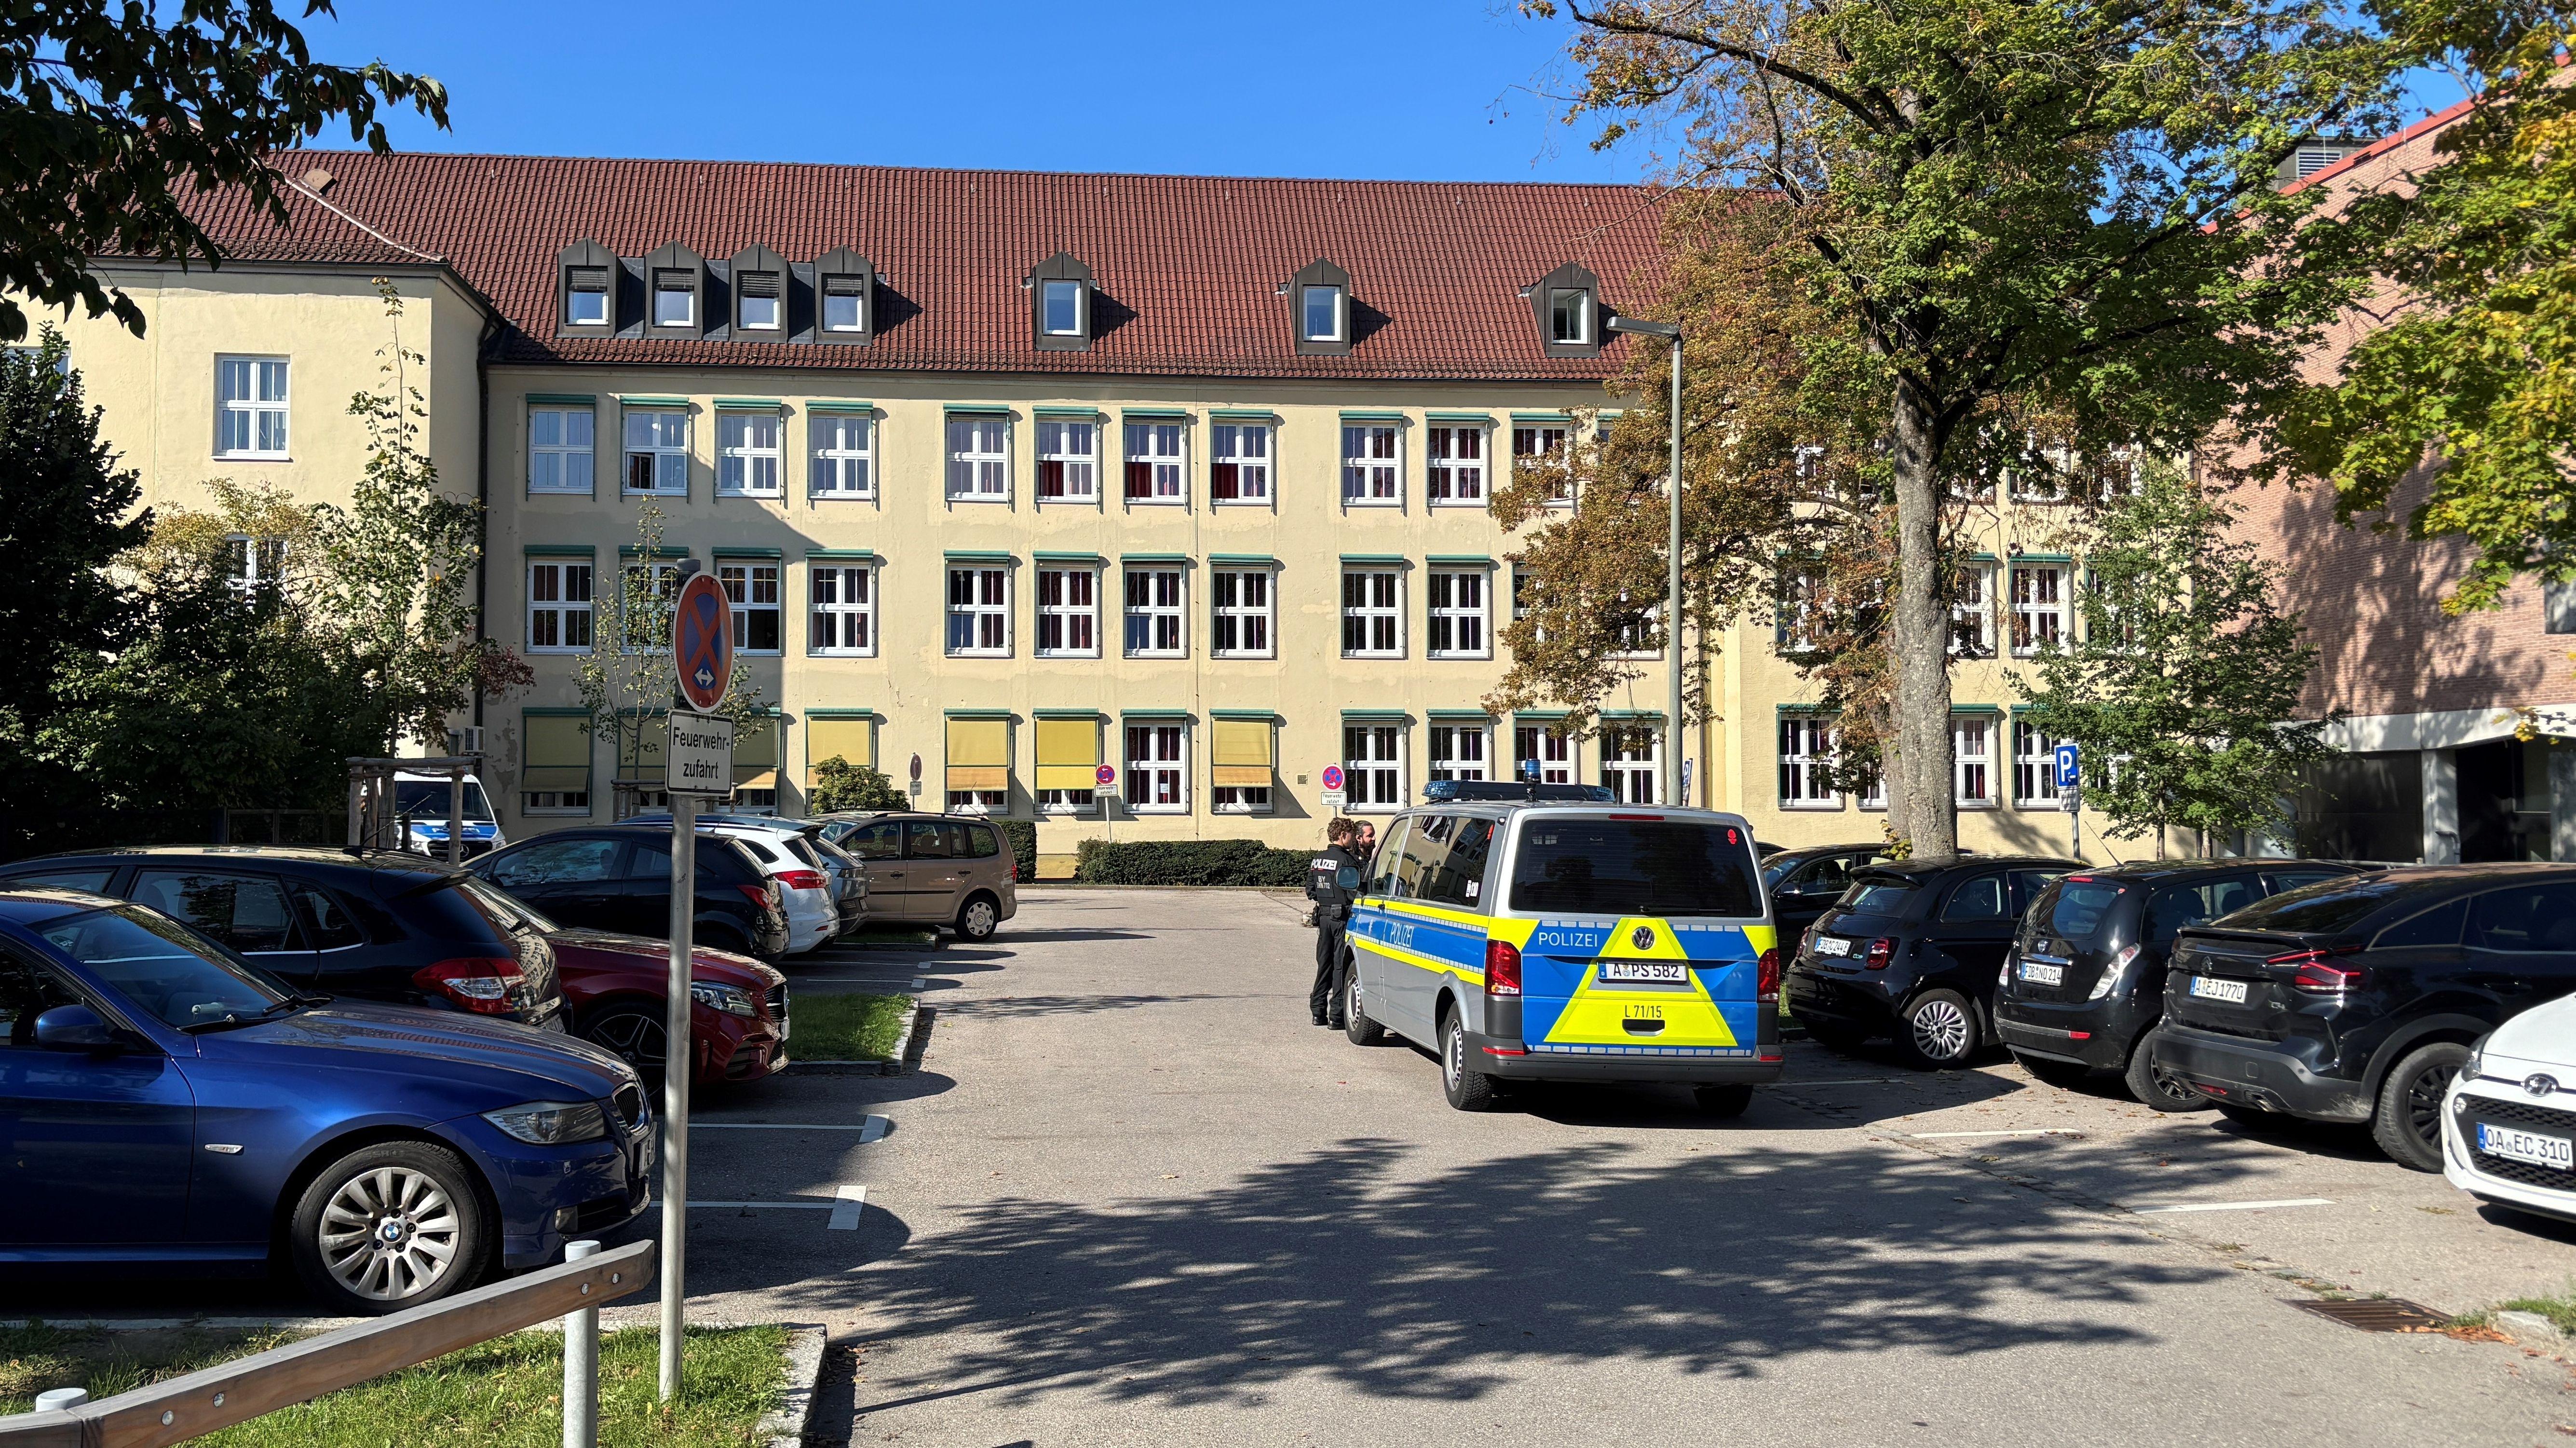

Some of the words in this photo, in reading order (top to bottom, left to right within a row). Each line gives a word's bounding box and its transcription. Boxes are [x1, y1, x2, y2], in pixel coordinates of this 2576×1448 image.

[673, 726, 730, 751] Feuerwehr-
[683, 759, 719, 779] zufahrt
[2060, 751, 2073, 782] P
[1311, 859, 1338, 871] POLIZEI
[1390, 922, 1414, 948] POLIZEI
[1538, 932, 1598, 947] POLIZEI
[1613, 963, 1622, 977] A
[1631, 964, 1650, 977] PS
[1654, 965, 1680, 978] 582
[2025, 965, 2035, 978] FDB
[2039, 967, 2047, 980] NO
[2048, 968, 2061, 981] 214
[2196, 979, 2201, 993] A
[2206, 981, 2218, 996] EJ
[2219, 983, 2243, 1000] 1770
[1625, 1005, 1630, 1018] L
[1634, 1005, 1662, 1018] 71/15
[2486, 1128, 2505, 1149] OA
[2514, 1134, 2534, 1155] EC
[2538, 1139, 2569, 1161] 310
